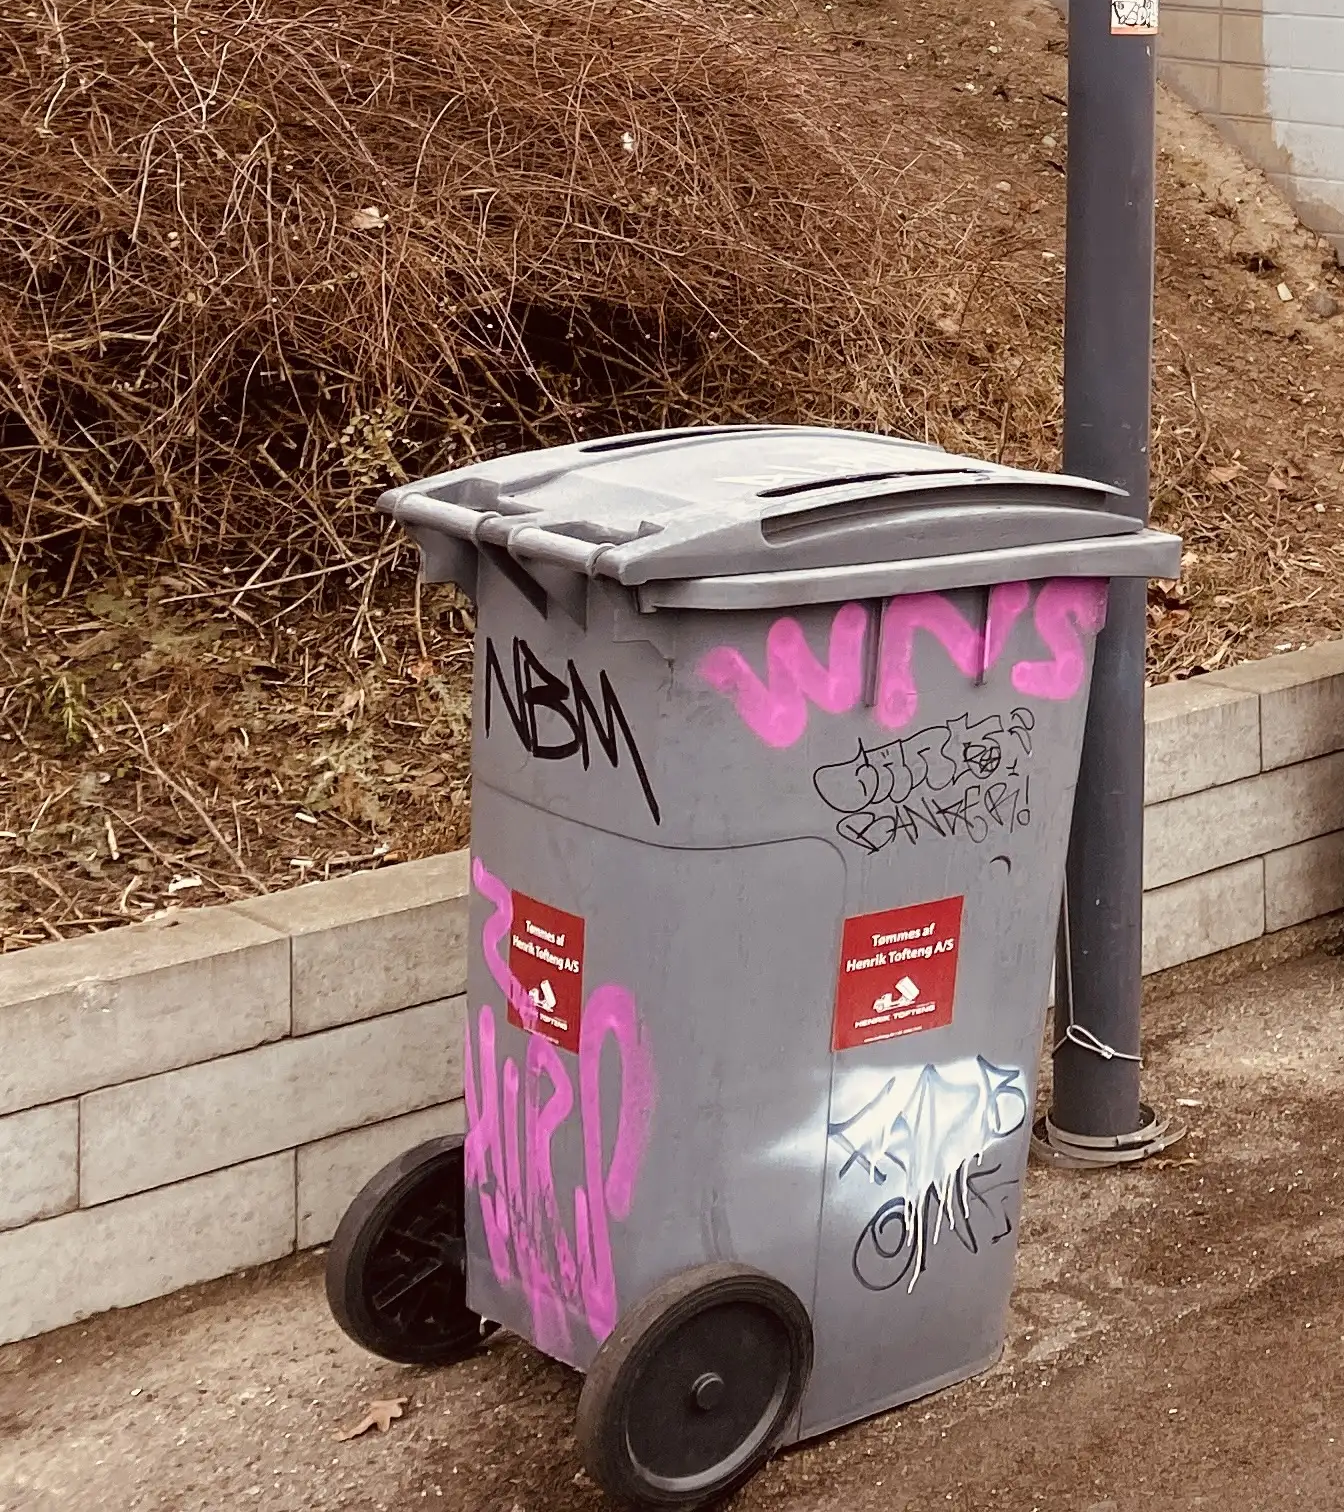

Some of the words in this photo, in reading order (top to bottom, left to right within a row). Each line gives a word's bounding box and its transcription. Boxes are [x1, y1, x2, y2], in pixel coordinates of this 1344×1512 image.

[556, 934, 566, 947] af
[871, 928, 921, 947] Tømmes
[922, 922, 936, 937] af
[512, 934, 536, 956] Henrik
[536, 945, 564, 971] Tofteng
[564, 958, 580, 974] A/S
[845, 952, 887, 973] Henrik
[888, 944, 933, 964] Tofteng
[934, 938, 955, 954] A/S
